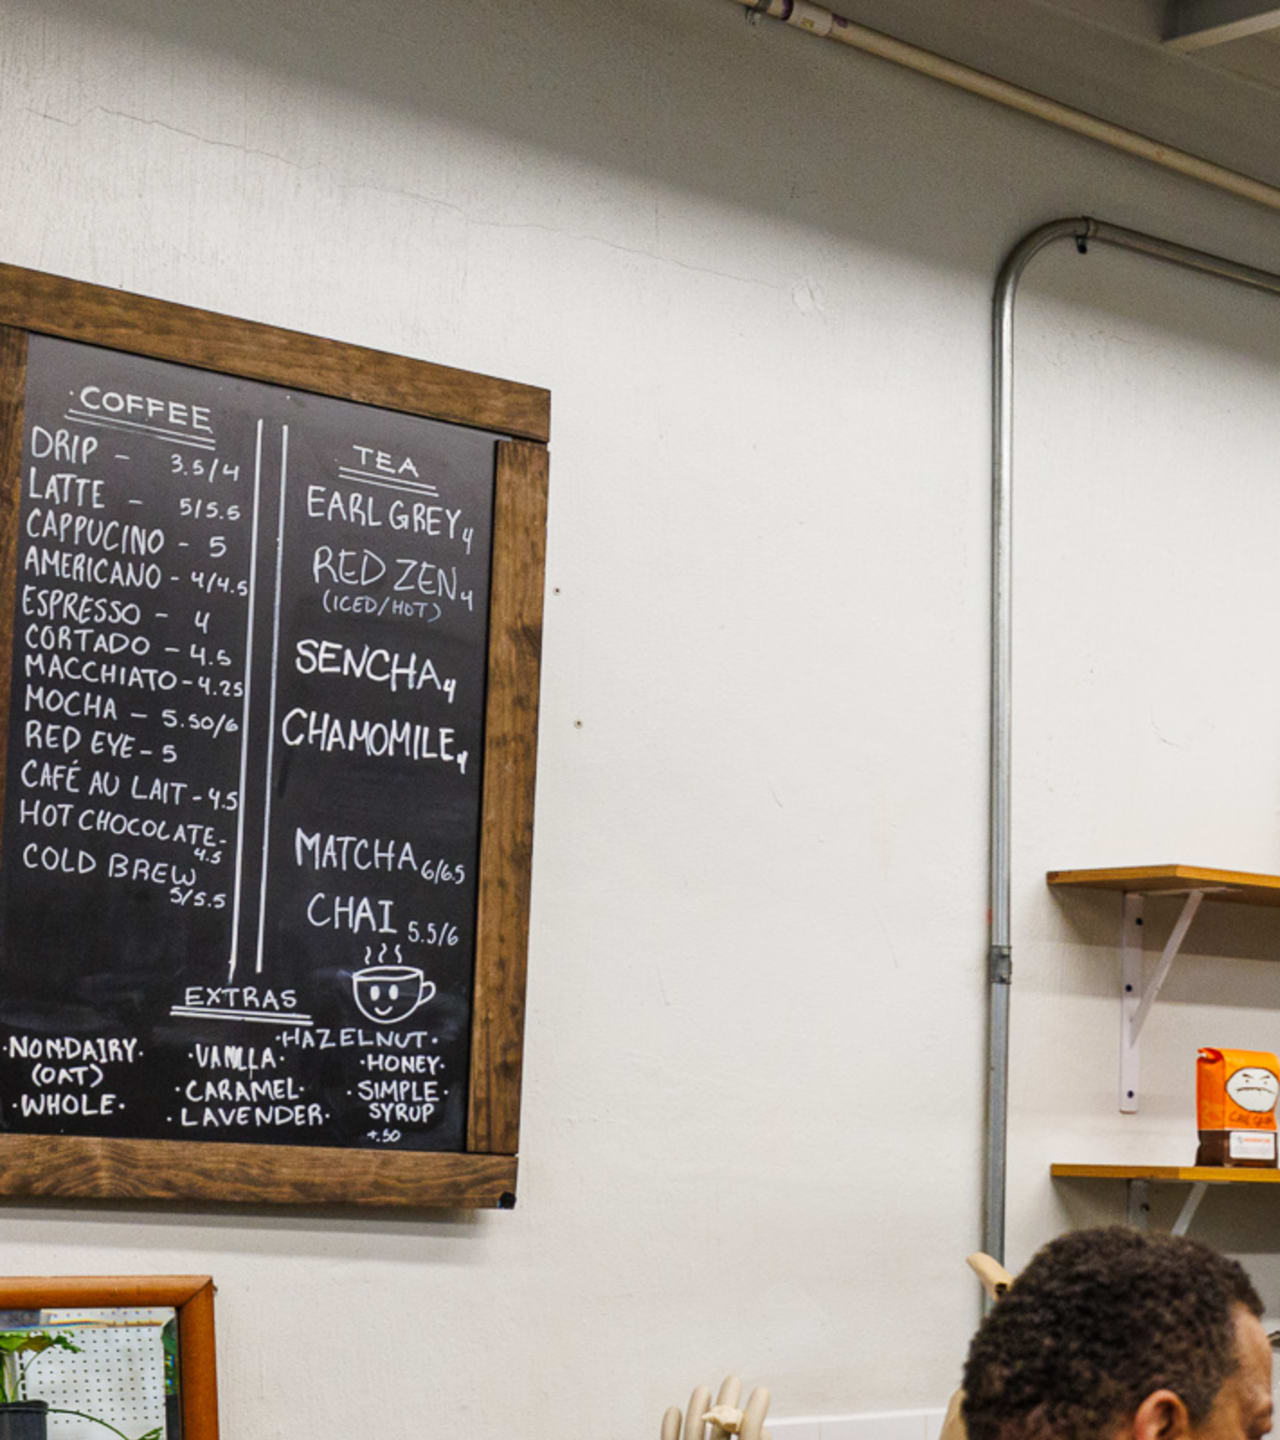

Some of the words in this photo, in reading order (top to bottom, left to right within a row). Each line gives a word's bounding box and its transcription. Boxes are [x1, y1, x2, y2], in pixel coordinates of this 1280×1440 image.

[80, 386, 214, 434] COFFEE
[31, 425, 98, 464] DRIP
[170, 453, 240, 483] 3.5/4
[353, 444, 420, 478] TEA
[29, 466, 105, 508] LATTE
[179, 498, 241, 521] 5/5.5
[26, 508, 164, 555] CAPPUCINO
[209, 537, 227, 558] 5
[307, 485, 382, 527] EARL
[389, 500, 462, 540] GREY
[462, 527, 474, 555] 4
[24, 546, 162, 590] AMERICANO
[191, 571, 248, 597] 4/4.5
[313, 545, 386, 586] RED
[393, 559, 457, 601] ZEN
[461, 590, 473, 612] 4
[22, 585, 141, 626] ESPRESSO
[194, 611, 210, 634] 4
[323, 589, 442, 623] (ICED/HOT)
[24, 623, 150, 656] CORTADO
[190, 644, 232, 667] 4.5
[25, 654, 177, 691] MACCHIATO
[198, 677, 244, 697] 4.25
[295, 639, 442, 692] SENCHA
[443, 678, 456, 704] 4
[25, 684, 118, 720] MOCHA
[25, 720, 81, 753] RED
[91, 731, 136, 759] EYE
[162, 745, 177, 763] 5
[282, 707, 455, 762] CHAMOMILE
[88, 771, 120, 797] AU
[131, 776, 188, 805] LAIT
[208, 787, 239, 811] 4.5
[20, 799, 74, 827] HOT
[23, 842, 97, 874] COLD
[108, 853, 196, 887] BREW
[194, 849, 222, 865] 4.5
[295, 827, 418, 871] MATCHA
[307, 892, 397, 934] CHAI
[408, 920, 459, 947] 5.5/6
[185, 987, 298, 1010] EXTRAS
[282, 1028, 428, 1050] HAZELNUT
[32, 1063, 104, 1088] (OAT)
[365, 1054, 440, 1074] HONEY
[21, 1093, 117, 1117] WHOLE
[185, 1076, 299, 1103] CARAMEL
[357, 1080, 439, 1102] SIMPLE
[181, 1103, 323, 1128] LAVENDER
[369, 1103, 435, 1124] SYRUP
